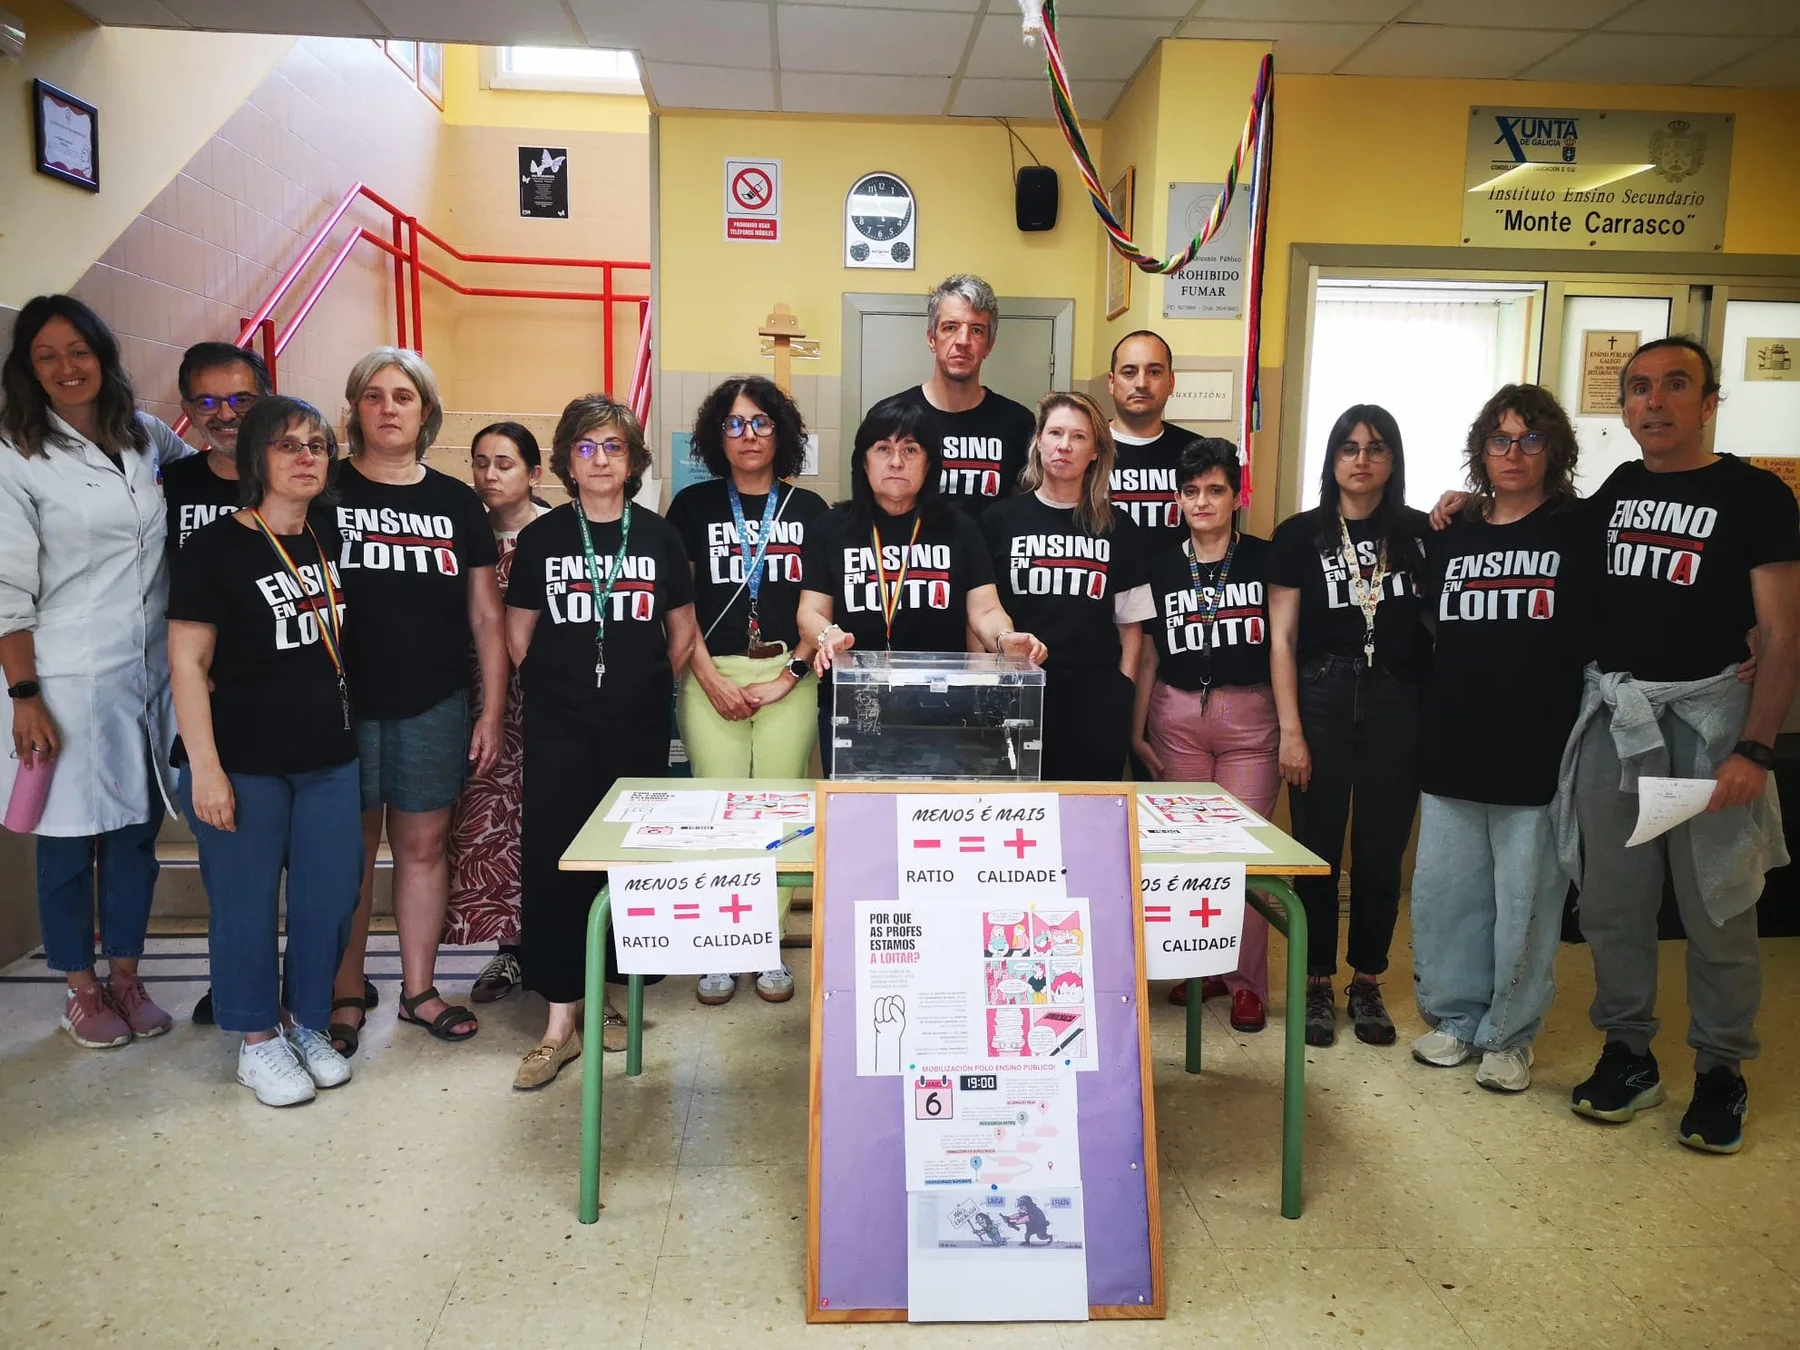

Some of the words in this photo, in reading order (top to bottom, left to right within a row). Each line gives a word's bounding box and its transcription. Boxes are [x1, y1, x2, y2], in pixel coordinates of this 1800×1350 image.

[1494, 116, 1579, 163] XUNTA
[1520, 138, 1530, 146] DE
[1531, 138, 1561, 147] GALICIA
[868, 185, 874, 193] 11
[879, 182, 886, 190] 12
[1488, 187, 1556, 202] Instituto
[1563, 187, 1615, 204] Ensino
[1622, 188, 1705, 206] Secundario
[867, 226, 872, 234] 7
[877, 230, 883, 238] 6
[1170, 269, 1239, 281] PROHIBIDO
[1181, 286, 1226, 296] FUMAR
[336, 506, 454, 540] ENSINO
[1608, 499, 1718, 538] ENSINO
[340, 529, 363, 542] EN
[708, 520, 804, 546] ENSNO
[1607, 529, 1619, 544] EN
[709, 545, 729, 557] EN
[1010, 534, 1111, 562] ENSINO
[340, 541, 459, 577] LOITA
[844, 543, 951, 574] ENSINO
[1010, 557, 1031, 570] EN
[1445, 550, 1561, 581] ENSINO
[1607, 543, 1702, 586] LOITA
[545, 555, 657, 583] ENSINO
[710, 553, 803, 585] LOTA
[1325, 569, 1347, 584] EN
[844, 572, 866, 585] EN
[1010, 566, 1108, 600] LOITA
[546, 582, 568, 596] EN
[1443, 580, 1463, 593] EN
[272, 601, 298, 620] EN
[1439, 588, 1555, 621] LOITA
[1166, 615, 1184, 629] EN
[1167, 616, 1265, 655] LOITA
[912, 806, 978, 823] MENOS
[981, 803, 994, 822] É
[996, 806, 1045, 823] MAIS
[624, 877, 688, 893] MENOS
[694, 873, 707, 890] É
[709, 872, 761, 889] MAIS
[907, 870, 954, 883] RATIO
[977, 869, 1056, 884] CALIDADE
[1167, 875, 1179, 892] É
[1182, 877, 1231, 892] MAIS
[870, 913, 889, 924] POR
[893, 913, 912, 925] QUE
[870, 926, 883, 937] AS
[886, 925, 922, 937] PROFES
[622, 936, 669, 948] RATIO
[692, 932, 773, 948] CALIDADE
[870, 939, 915, 951] ESTAMOS
[1162, 936, 1237, 952] CALIDADE
[870, 952, 877, 964] A
[880, 952, 920, 964] LOITAR?
[967, 1077, 995, 1089] 19:00
[925, 1092, 942, 1116] 6
